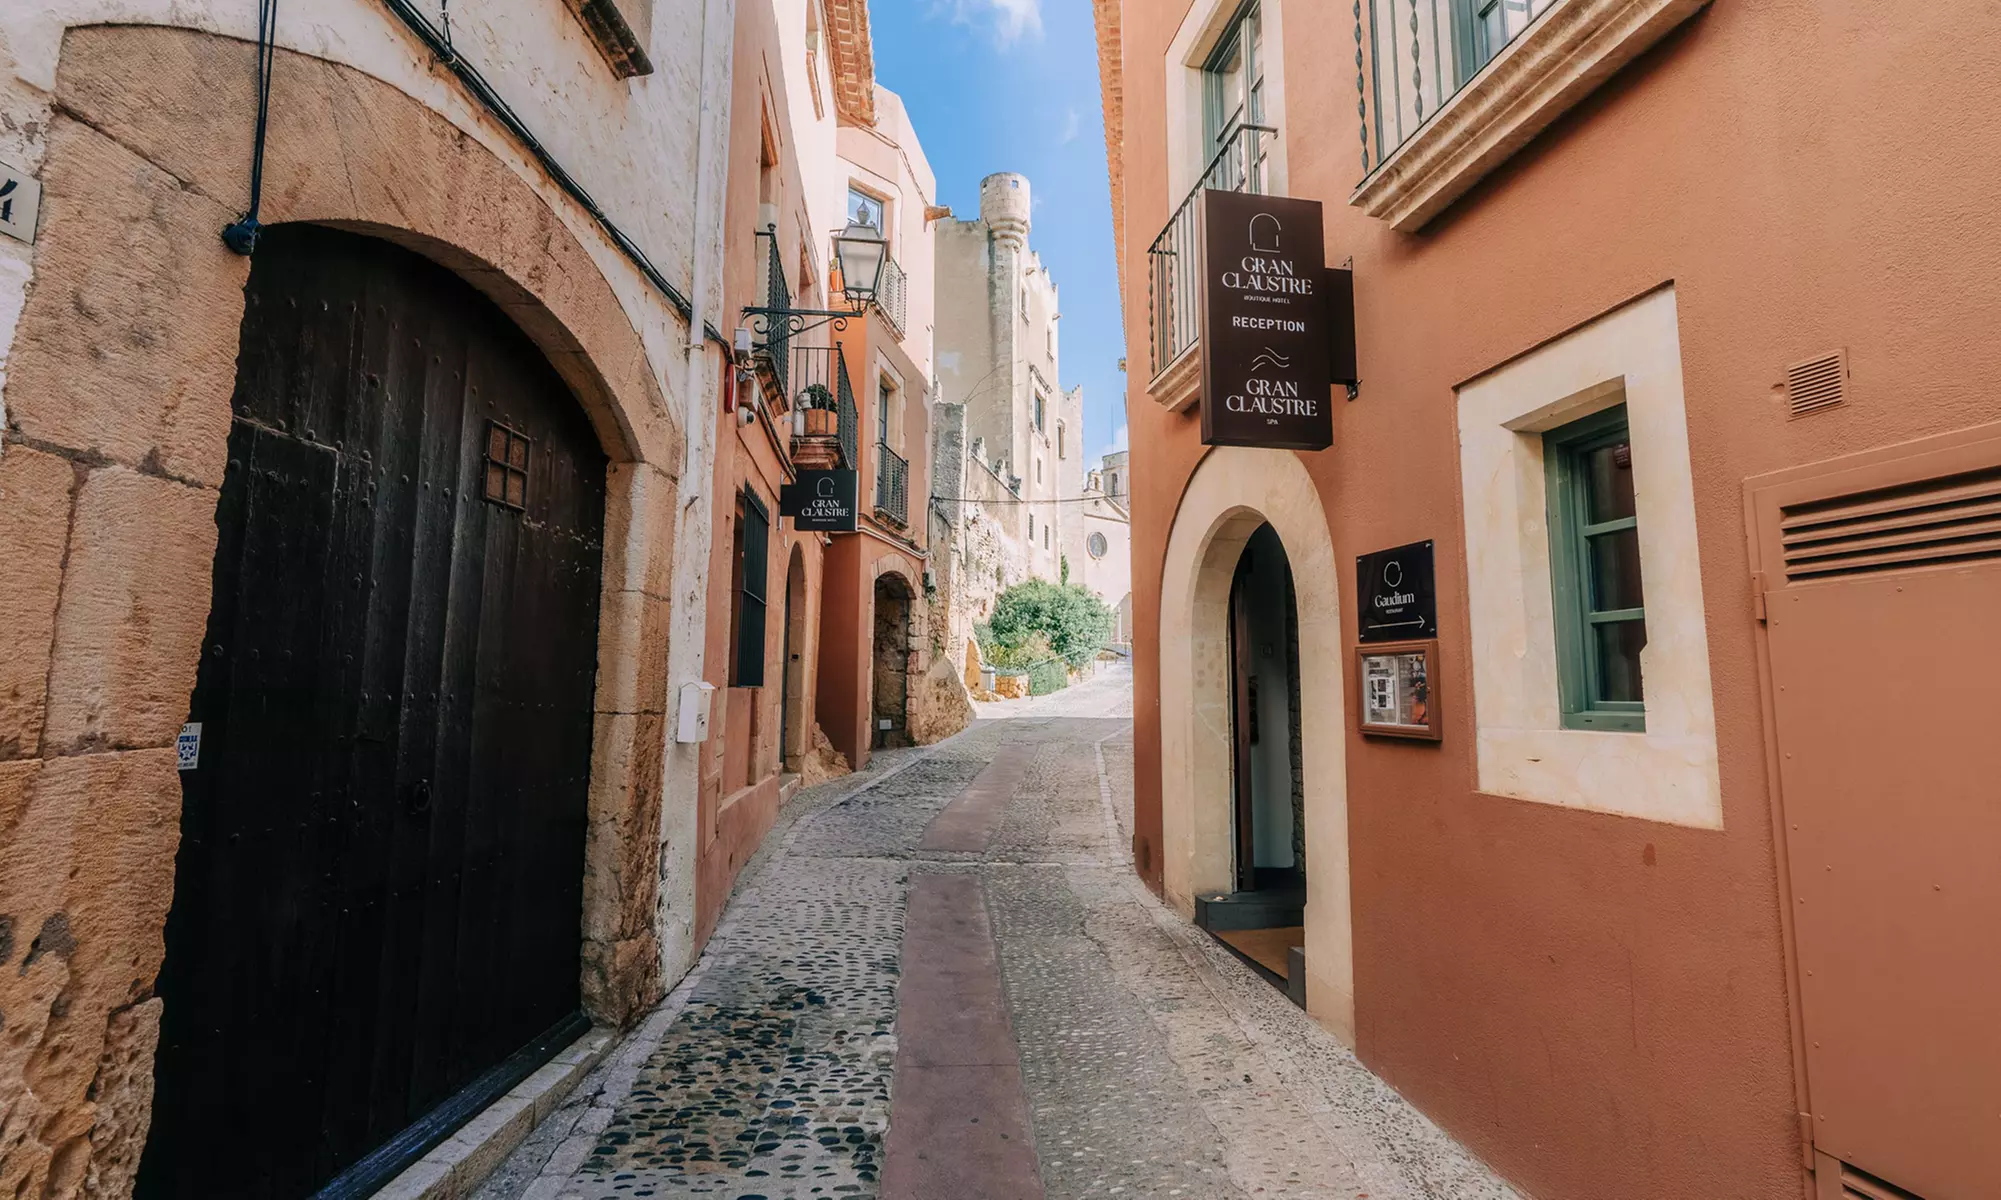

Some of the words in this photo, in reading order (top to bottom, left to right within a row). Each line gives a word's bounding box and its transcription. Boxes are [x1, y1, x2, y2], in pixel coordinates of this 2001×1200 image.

[1241, 256, 1293, 276] GRAN
[1222, 271, 1313, 294] CLAUSTRE
[1232, 316, 1305, 332] RECEPTION
[1246, 378, 1298, 397] GRAN
[1226, 395, 1318, 416] CLAUSTRE
[801, 508, 849, 516] CLAUSTRE
[1374, 591, 1414, 607] Gaudium
